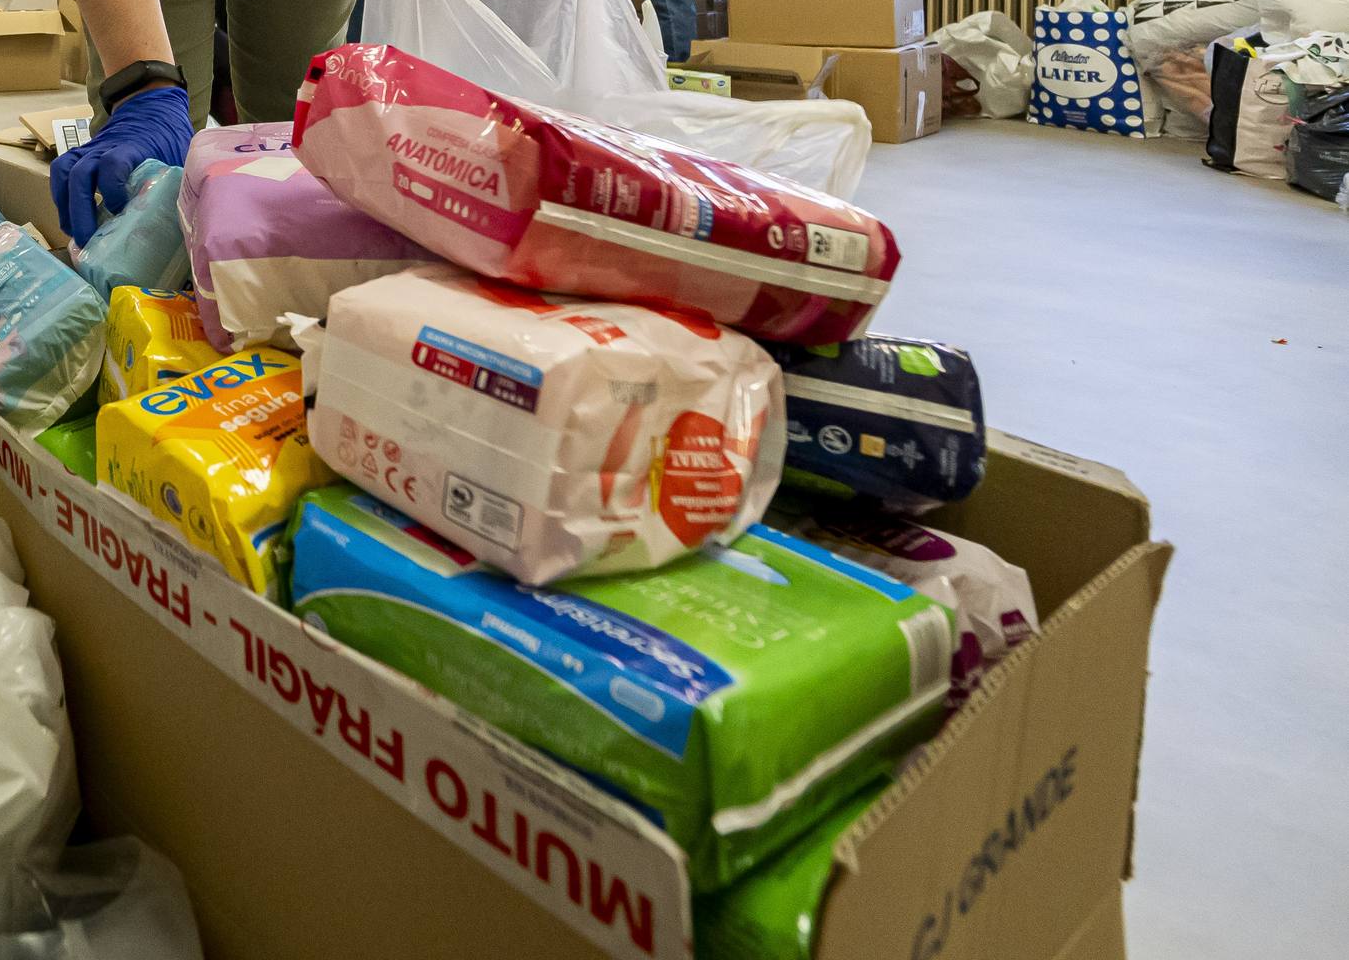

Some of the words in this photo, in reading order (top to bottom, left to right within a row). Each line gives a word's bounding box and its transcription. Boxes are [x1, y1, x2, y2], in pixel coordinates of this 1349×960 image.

[1041, 66, 1107, 83] LAFER
[385, 134, 501, 195] ANATÓMICA
[140, 353, 289, 416] evax
[211, 389, 258, 417] fina
[218, 390, 302, 433] segura
[56, 487, 192, 628] FRAGILE
[480, 612, 542, 653] Normal
[229, 616, 406, 784] FRÁGIL
[425, 756, 657, 955] MUITO
